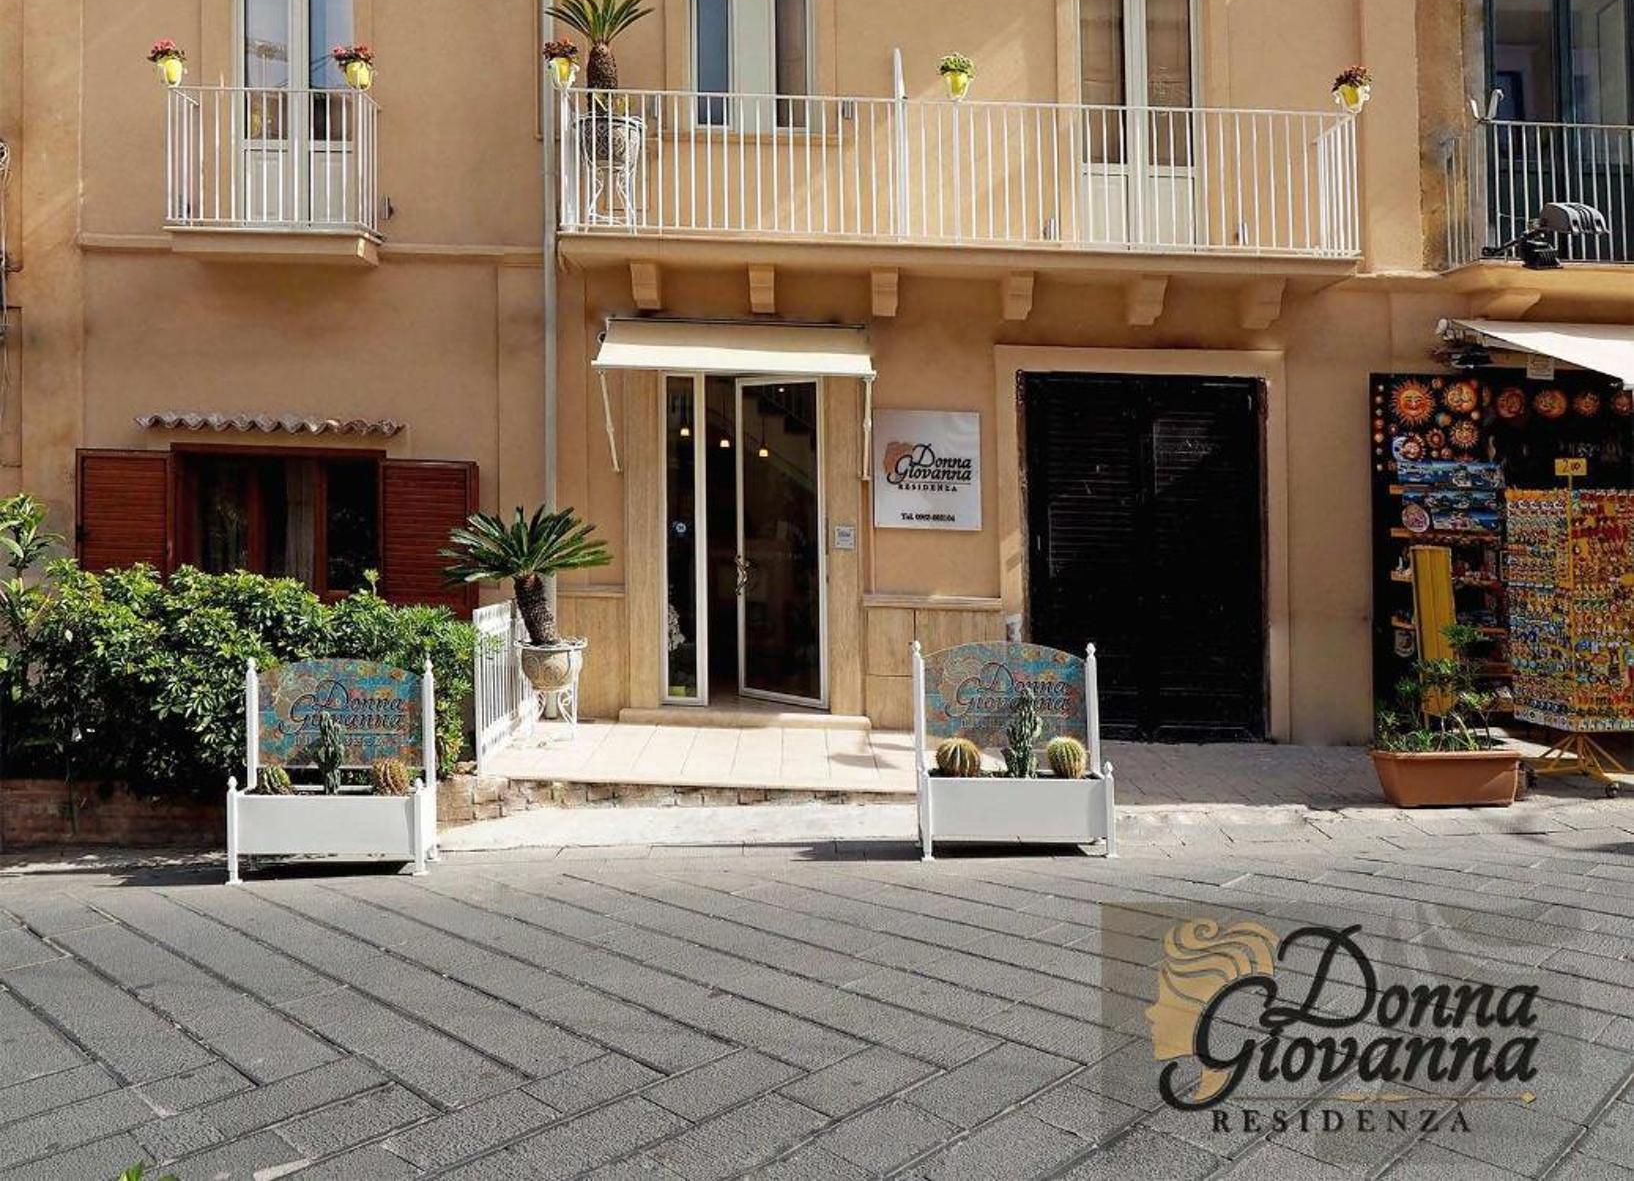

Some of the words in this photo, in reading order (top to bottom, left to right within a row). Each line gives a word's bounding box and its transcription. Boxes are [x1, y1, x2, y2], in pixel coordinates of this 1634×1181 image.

[886, 454, 971, 485] Giovanna
[909, 443, 971, 469] Donna
[898, 484, 958, 492] RESIDENZA
[312, 679, 405, 712] Donna
